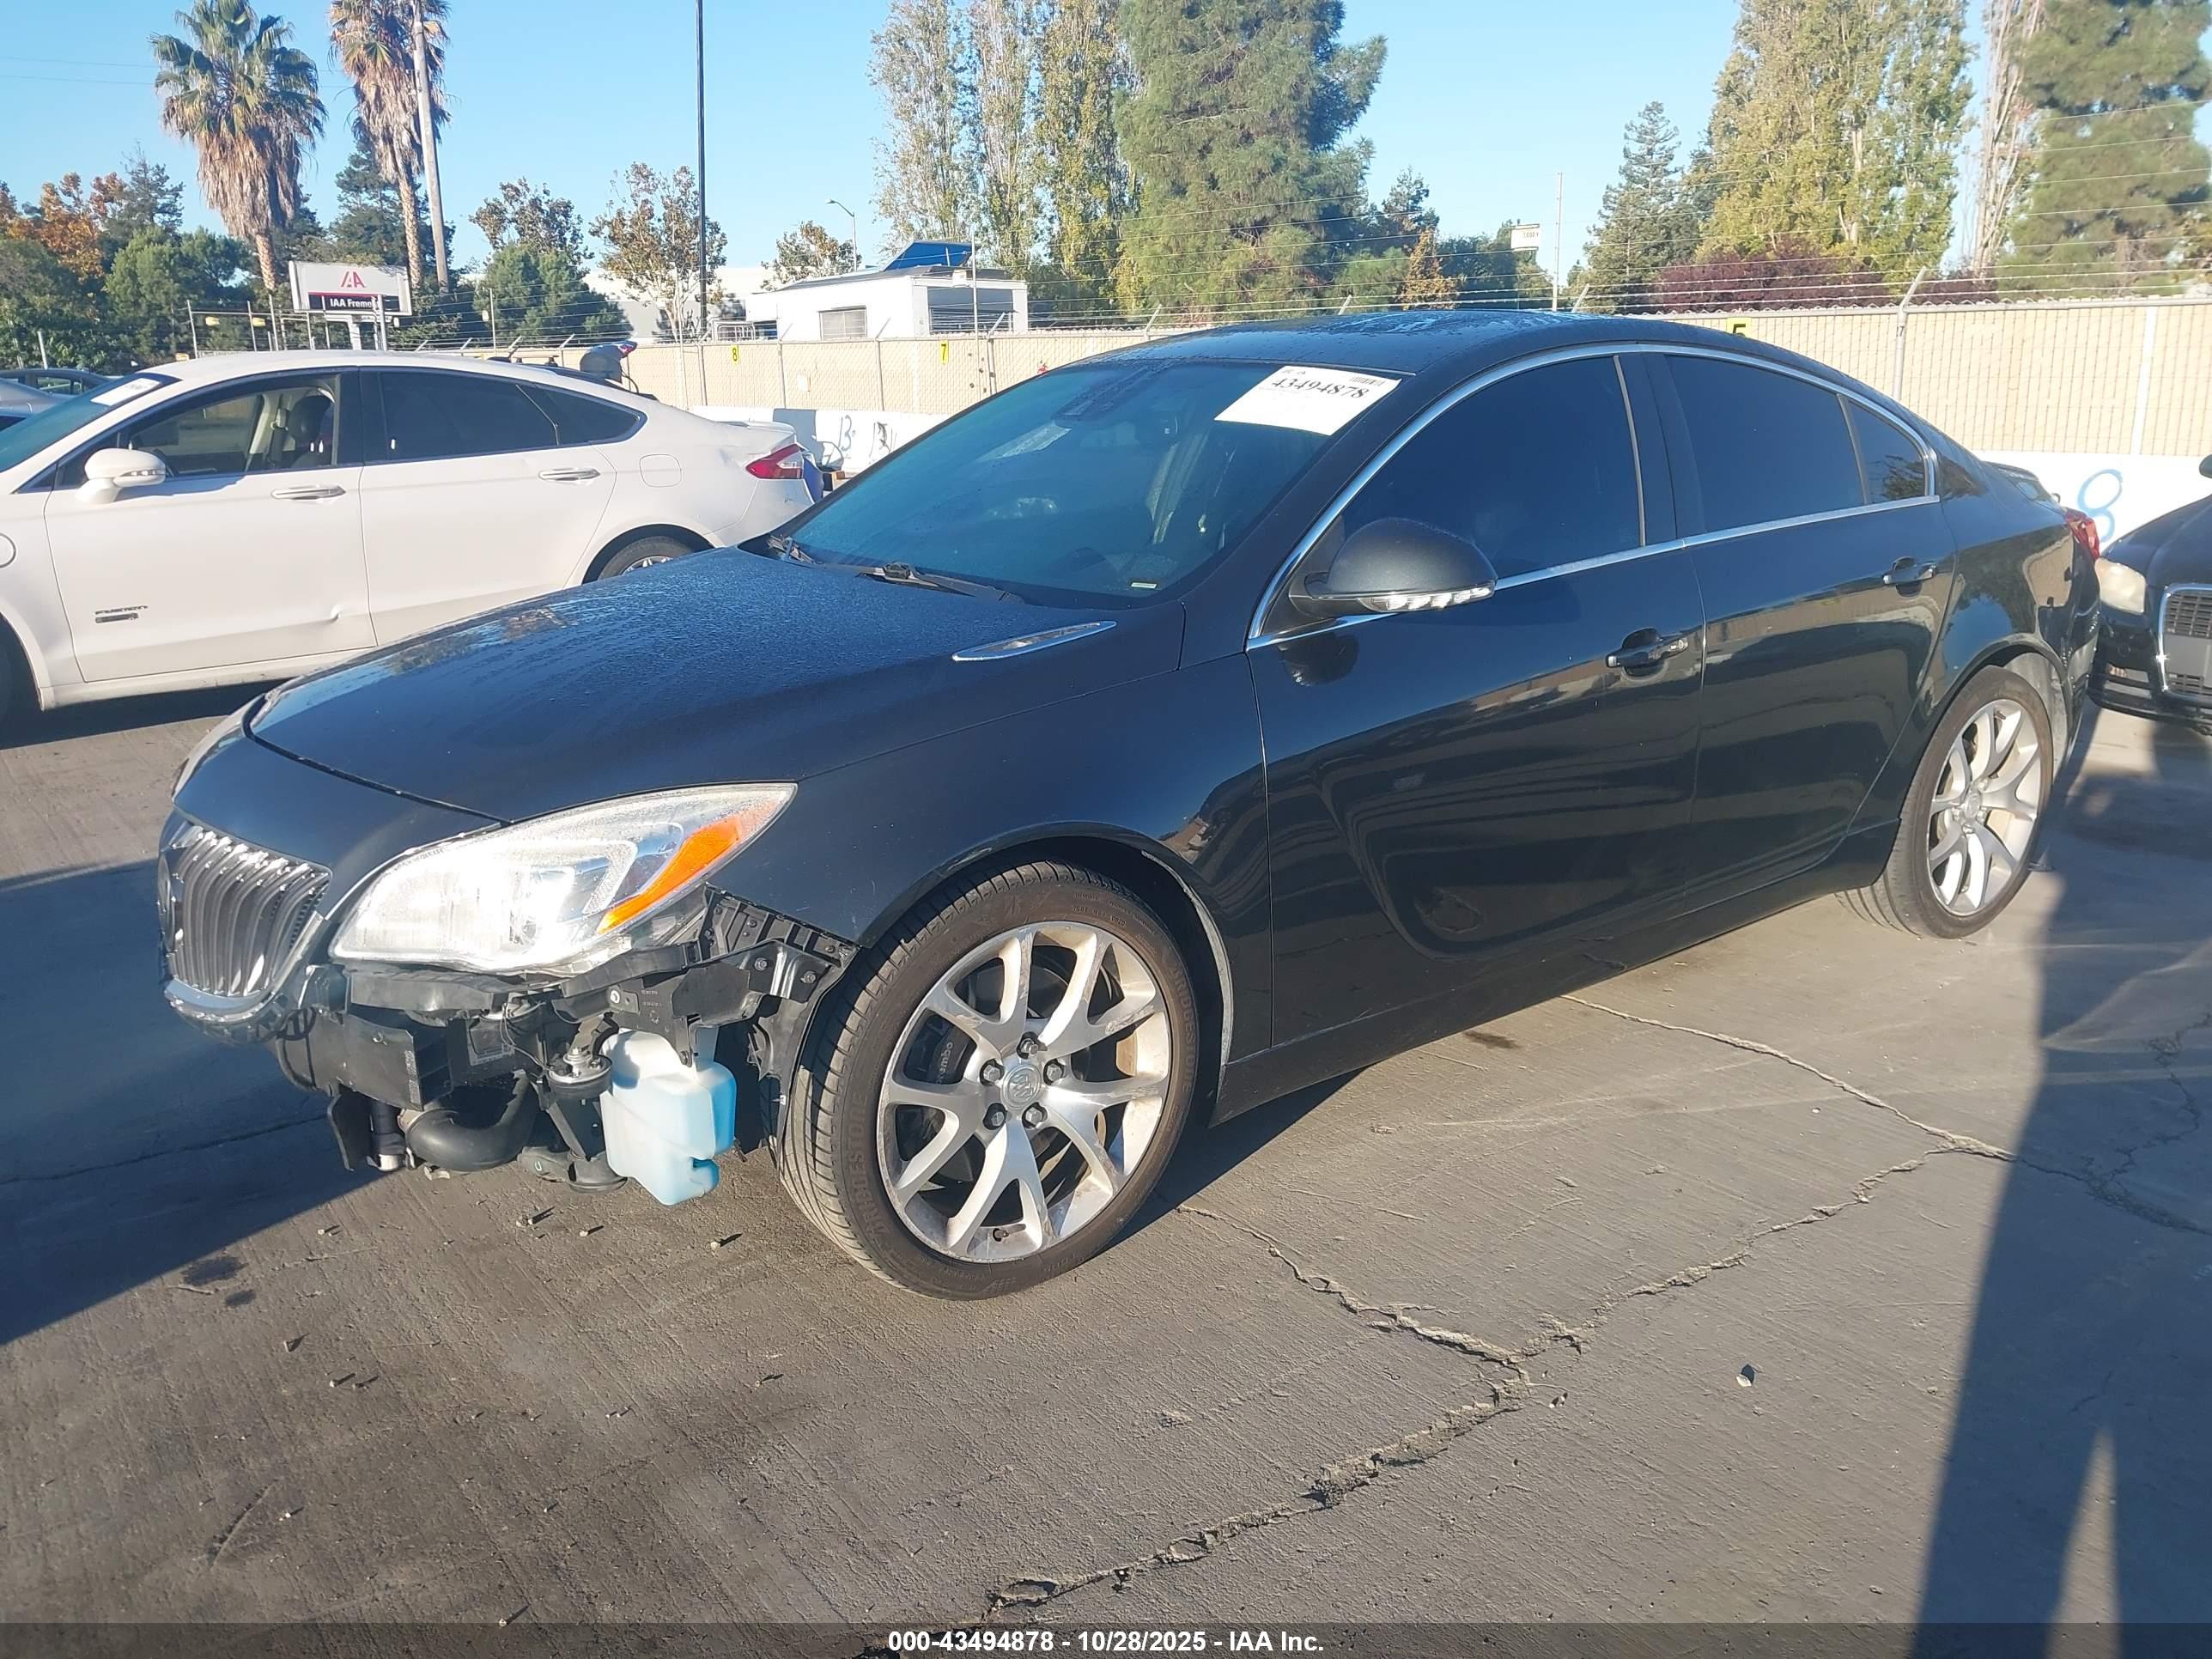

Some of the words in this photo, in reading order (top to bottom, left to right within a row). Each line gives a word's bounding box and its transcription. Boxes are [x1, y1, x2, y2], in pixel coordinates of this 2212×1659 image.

[330, 298, 346, 307] IAA
[348, 299, 378, 309] Fremo
[732, 347, 738, 362] 8
[940, 343, 947, 362] 7
[1270, 378, 1370, 399] 43494878
